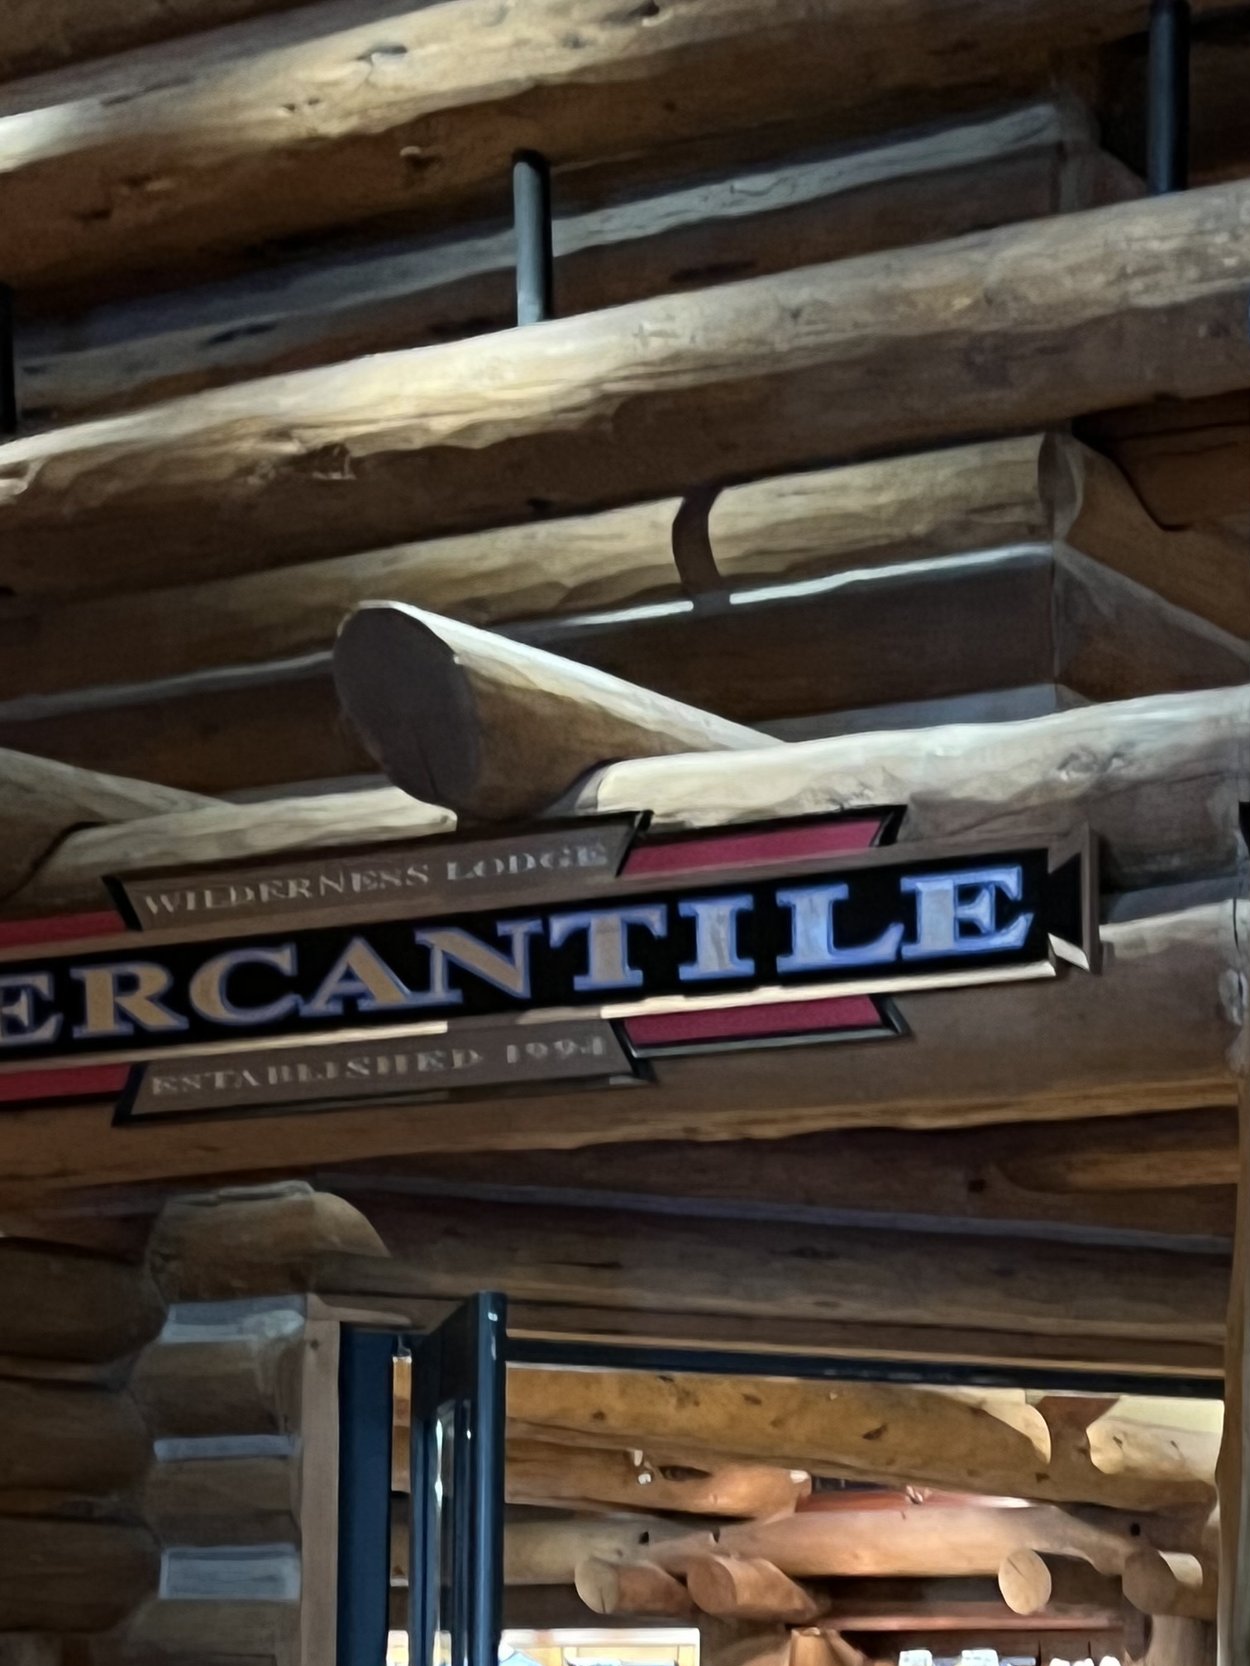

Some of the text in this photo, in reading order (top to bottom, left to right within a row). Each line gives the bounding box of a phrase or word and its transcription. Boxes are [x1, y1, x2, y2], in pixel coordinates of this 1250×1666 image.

[145, 844, 607, 915] WILDERNESS LODGE
[152, 1049, 483, 1095] ESTABLISHED
